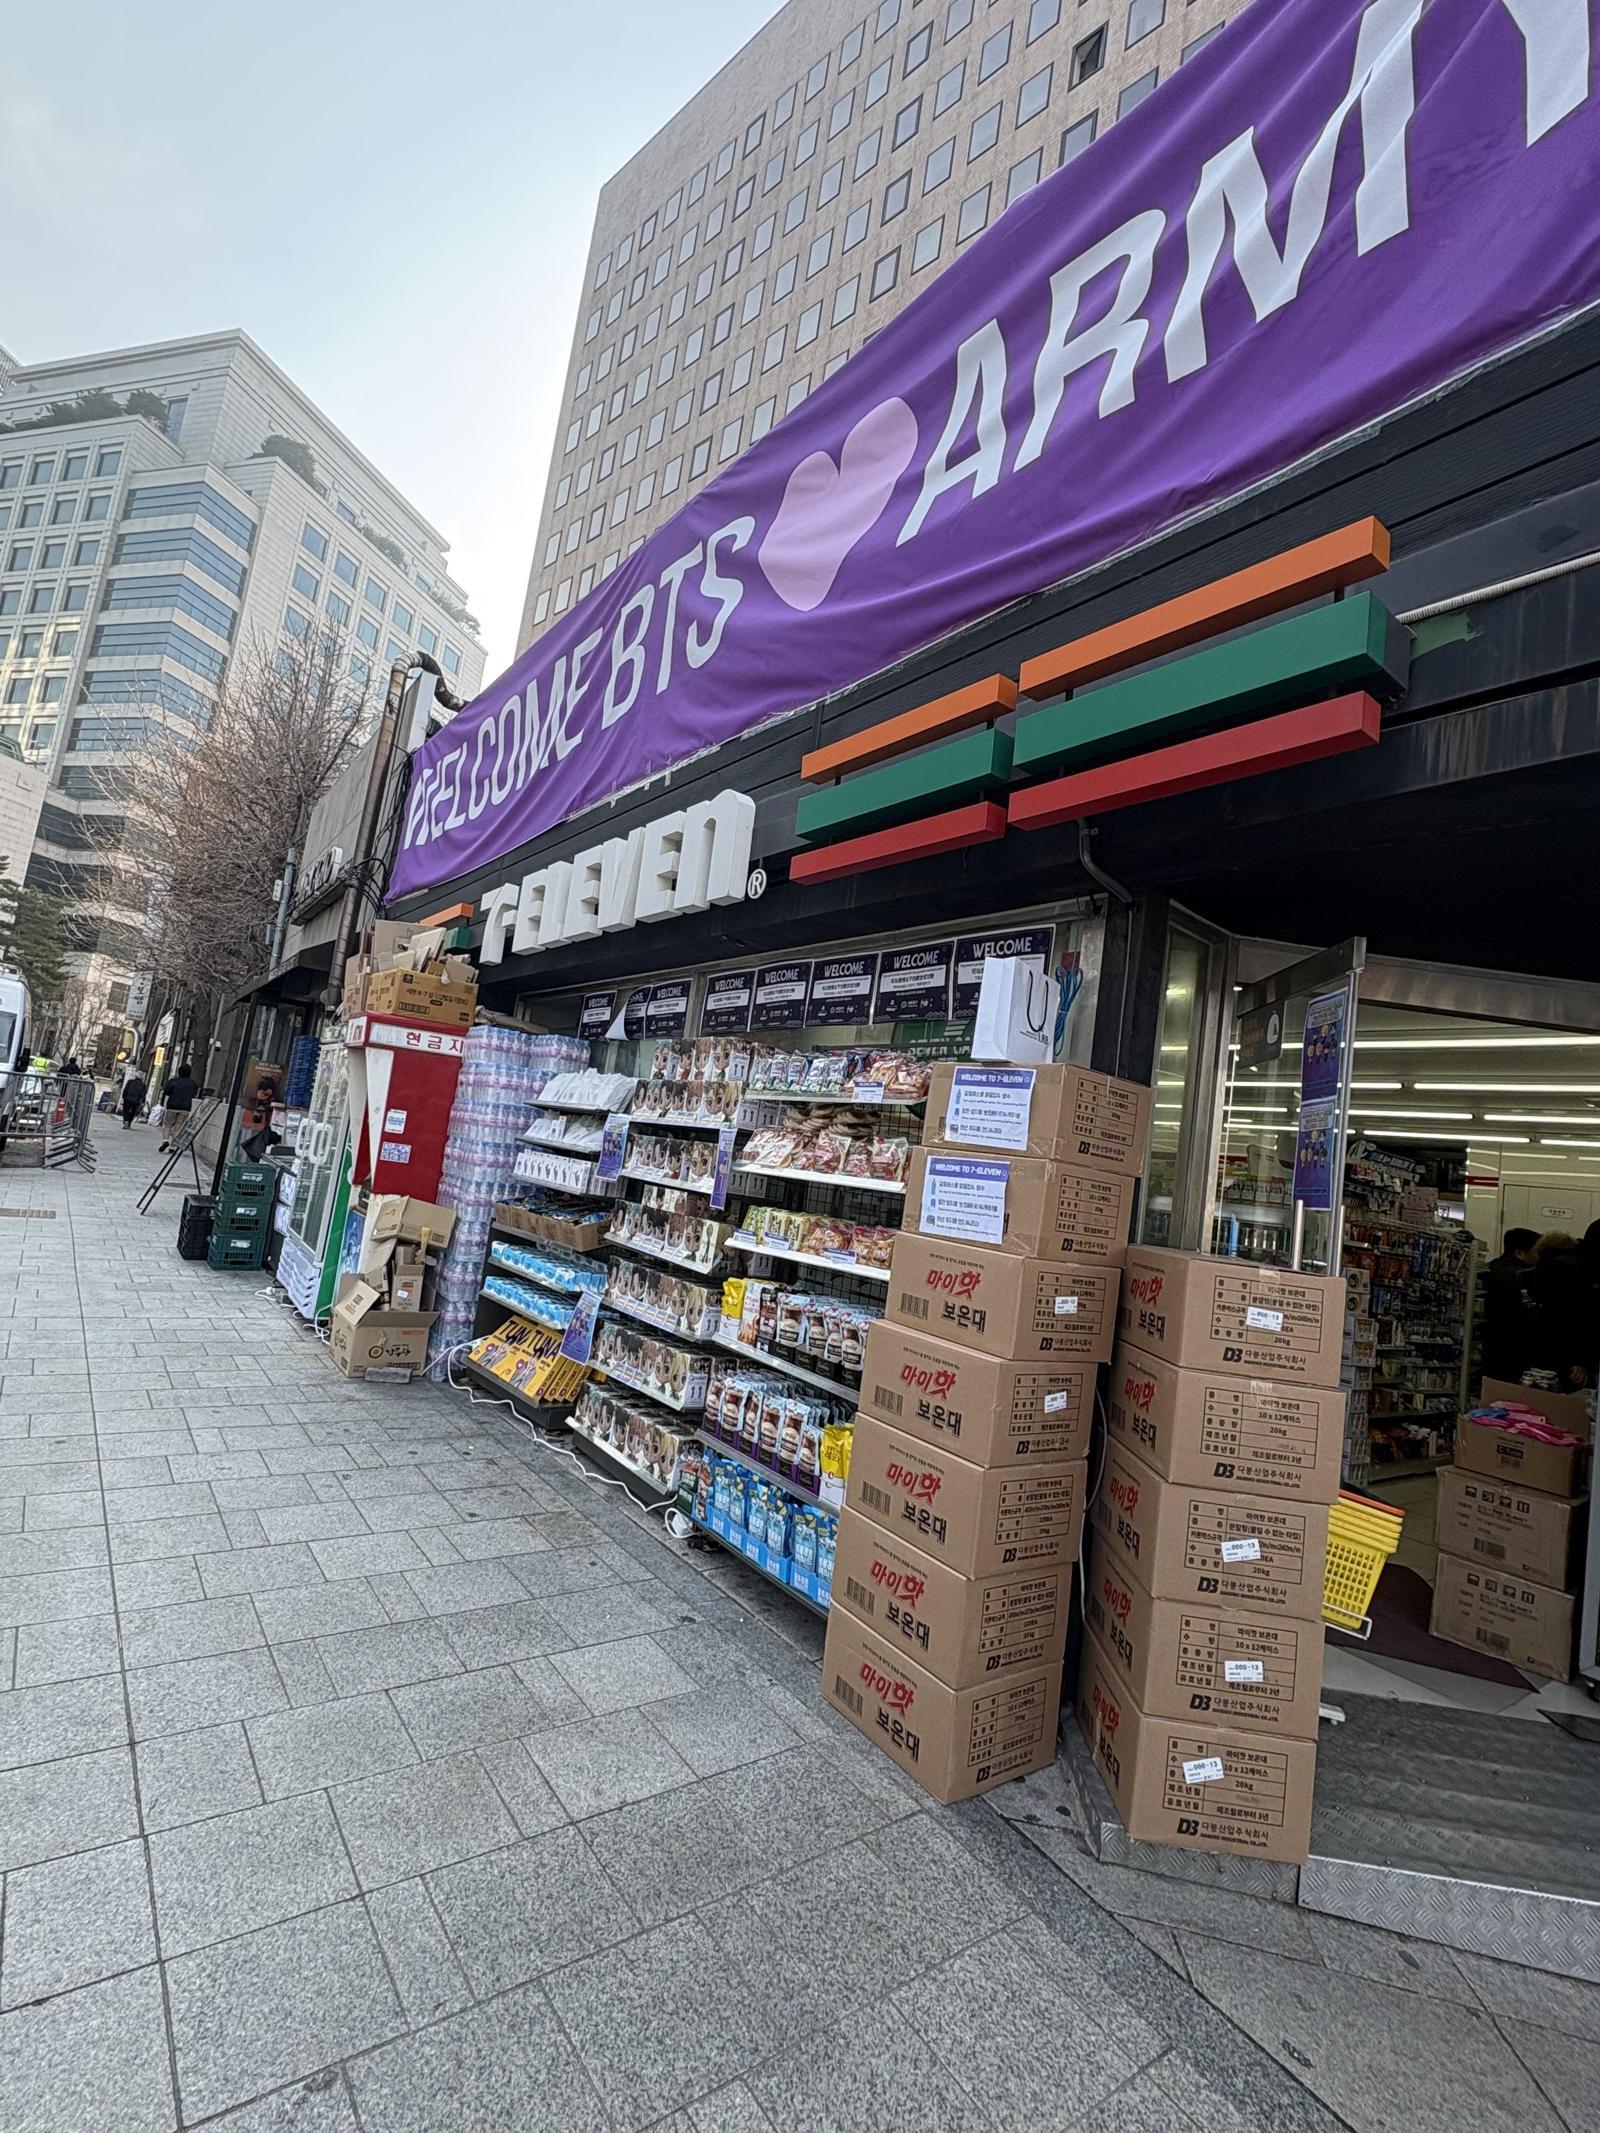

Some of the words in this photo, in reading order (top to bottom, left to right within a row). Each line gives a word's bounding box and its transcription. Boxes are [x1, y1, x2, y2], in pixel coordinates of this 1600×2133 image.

[404, 627, 602, 850] WELCOME
[602, 516, 755, 730] BTS
[894, 950, 939, 969] WELCOME
[973, 936, 1033, 958] WELCOME
[715, 977, 744, 991] WELCOME
[765, 968, 799, 984] WELCOME
[824, 961, 864, 978] WELCOME
[588, 996, 609, 1008] WELCOME
[656, 985, 682, 998] WELCOME
[935, 1164, 960, 1172] WELCOME
[971, 1166, 1001, 1176] 7-ELEVEN
[926, 1268, 982, 1301] 마이핫
[1130, 1276, 1163, 1308] 마이핫
[942, 1301, 987, 1335] 보온대
[1138, 1309, 1166, 1342] 보온대
[1274, 1337, 1291, 1346] 20kg
[900, 1362, 957, 1401] 마이핫
[1124, 1377, 1155, 1415] 마이핫
[916, 1399, 963, 1438] 보온대
[1131, 1411, 1157, 1452] 보온대
[1270, 1426, 1287, 1436] 20kg
[885, 1461, 942, 1506] 마이핫
[1110, 1477, 1139, 1519] 마이핫
[902, 1501, 947, 1544] 보온대
[1117, 1515, 1141, 1561] 보온대
[870, 1559, 926, 1608] 마이핫
[1252, 1566, 1270, 1576] 20kg
[886, 1602, 931, 1653] 보온대
[860, 1662, 915, 1720] 마이핫
[875, 1707, 921, 1764] 보온대
[1235, 1780, 1254, 1791] 20kg
